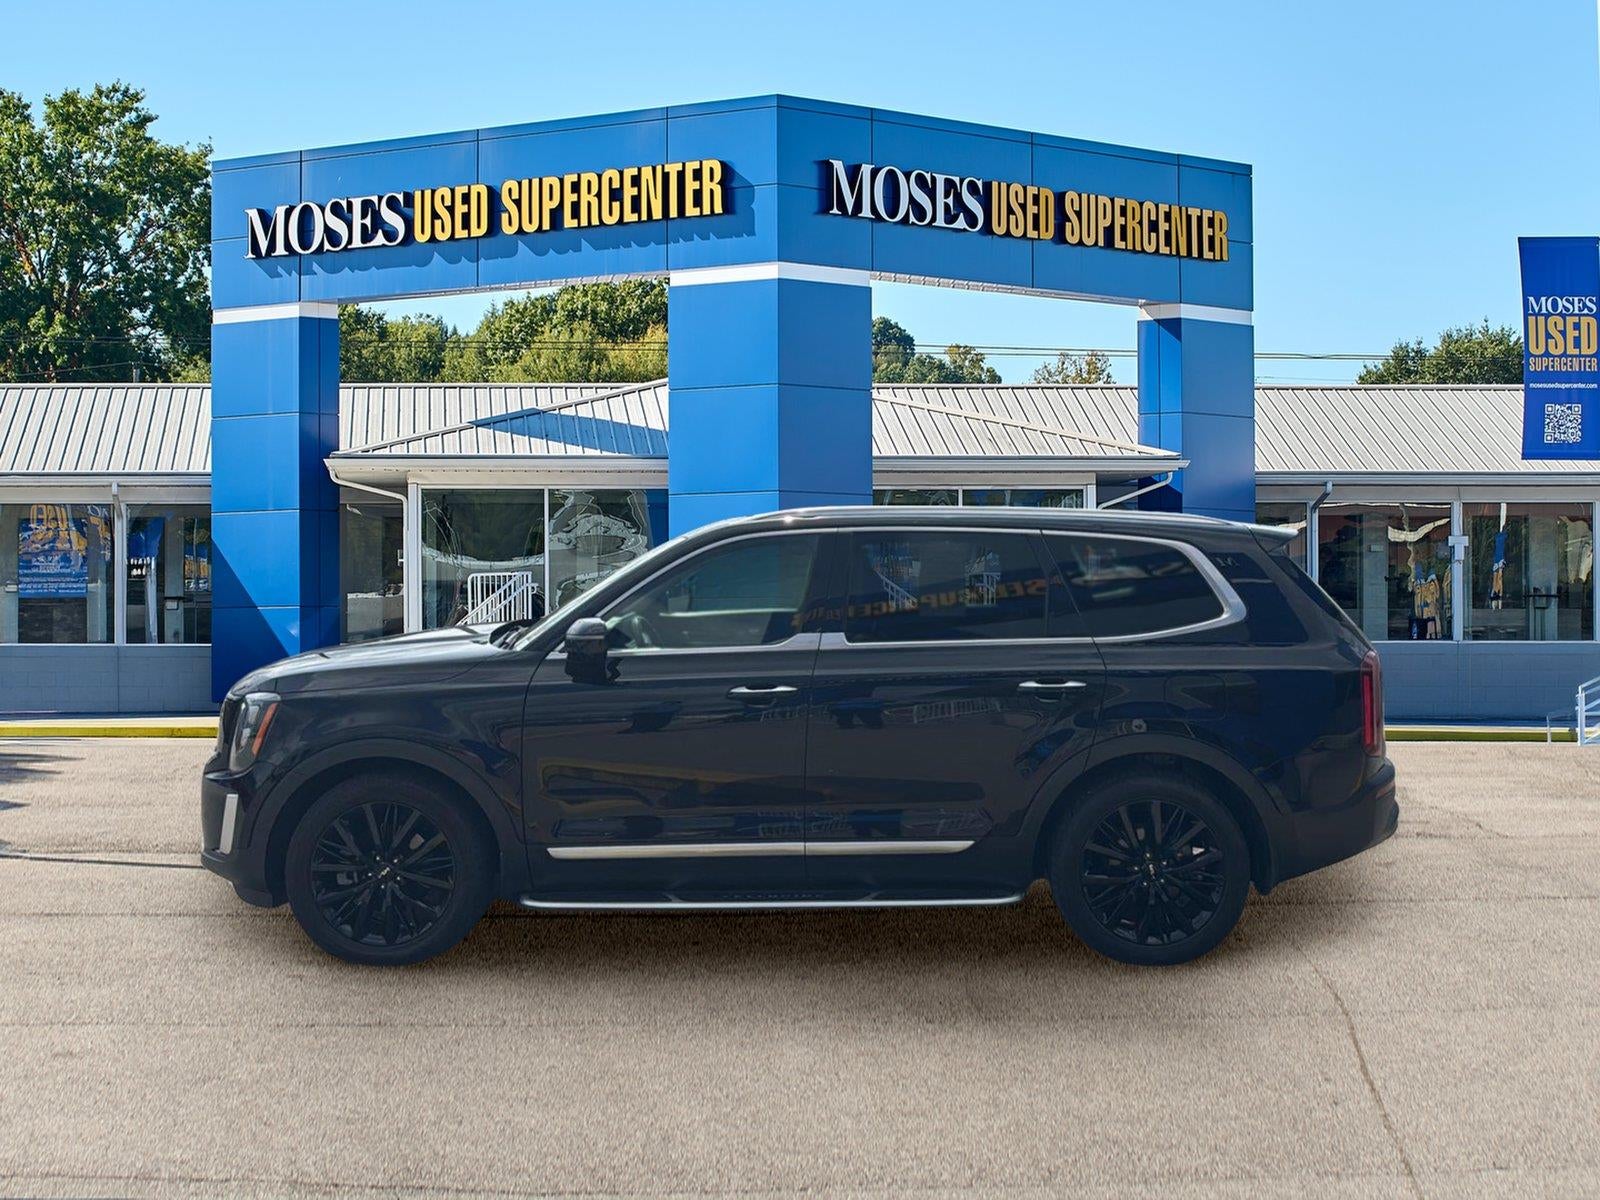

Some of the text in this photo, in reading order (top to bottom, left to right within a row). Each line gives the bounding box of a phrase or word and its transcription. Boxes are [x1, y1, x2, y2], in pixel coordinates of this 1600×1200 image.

[244, 158, 725, 260] MOSES USED SUPERCENTER
[828, 158, 1230, 262] MOSES USED SUPERCENTER
[1528, 296, 1597, 314] MOSES
[1528, 316, 1597, 355] USED
[1529, 357, 1597, 371] SUPERCENTER
